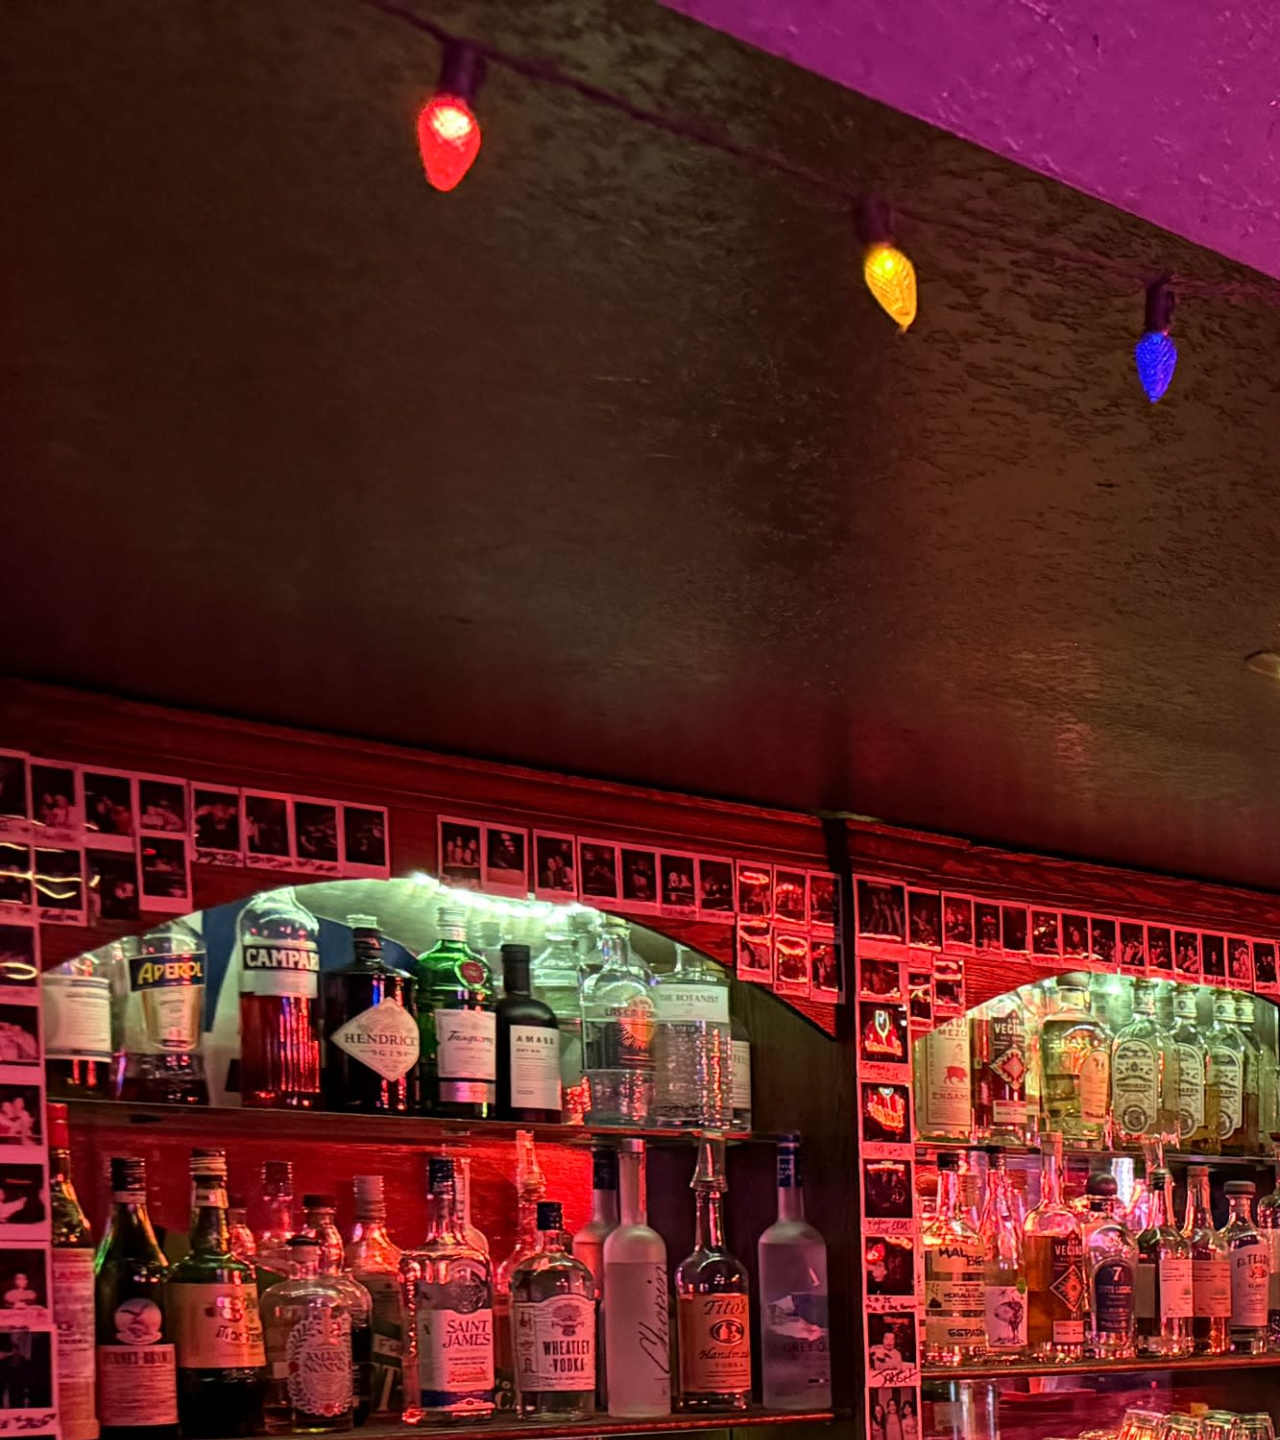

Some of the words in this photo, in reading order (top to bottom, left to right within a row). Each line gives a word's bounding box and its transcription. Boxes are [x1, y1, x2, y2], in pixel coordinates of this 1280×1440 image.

[246, 947, 319, 971] CAMPAR
[702, 1300, 747, 1316] Tito's
[446, 1318, 489, 1335] SAINT
[442, 1333, 492, 1347] JAMES
[543, 1340, 591, 1357] WHEATLEY
